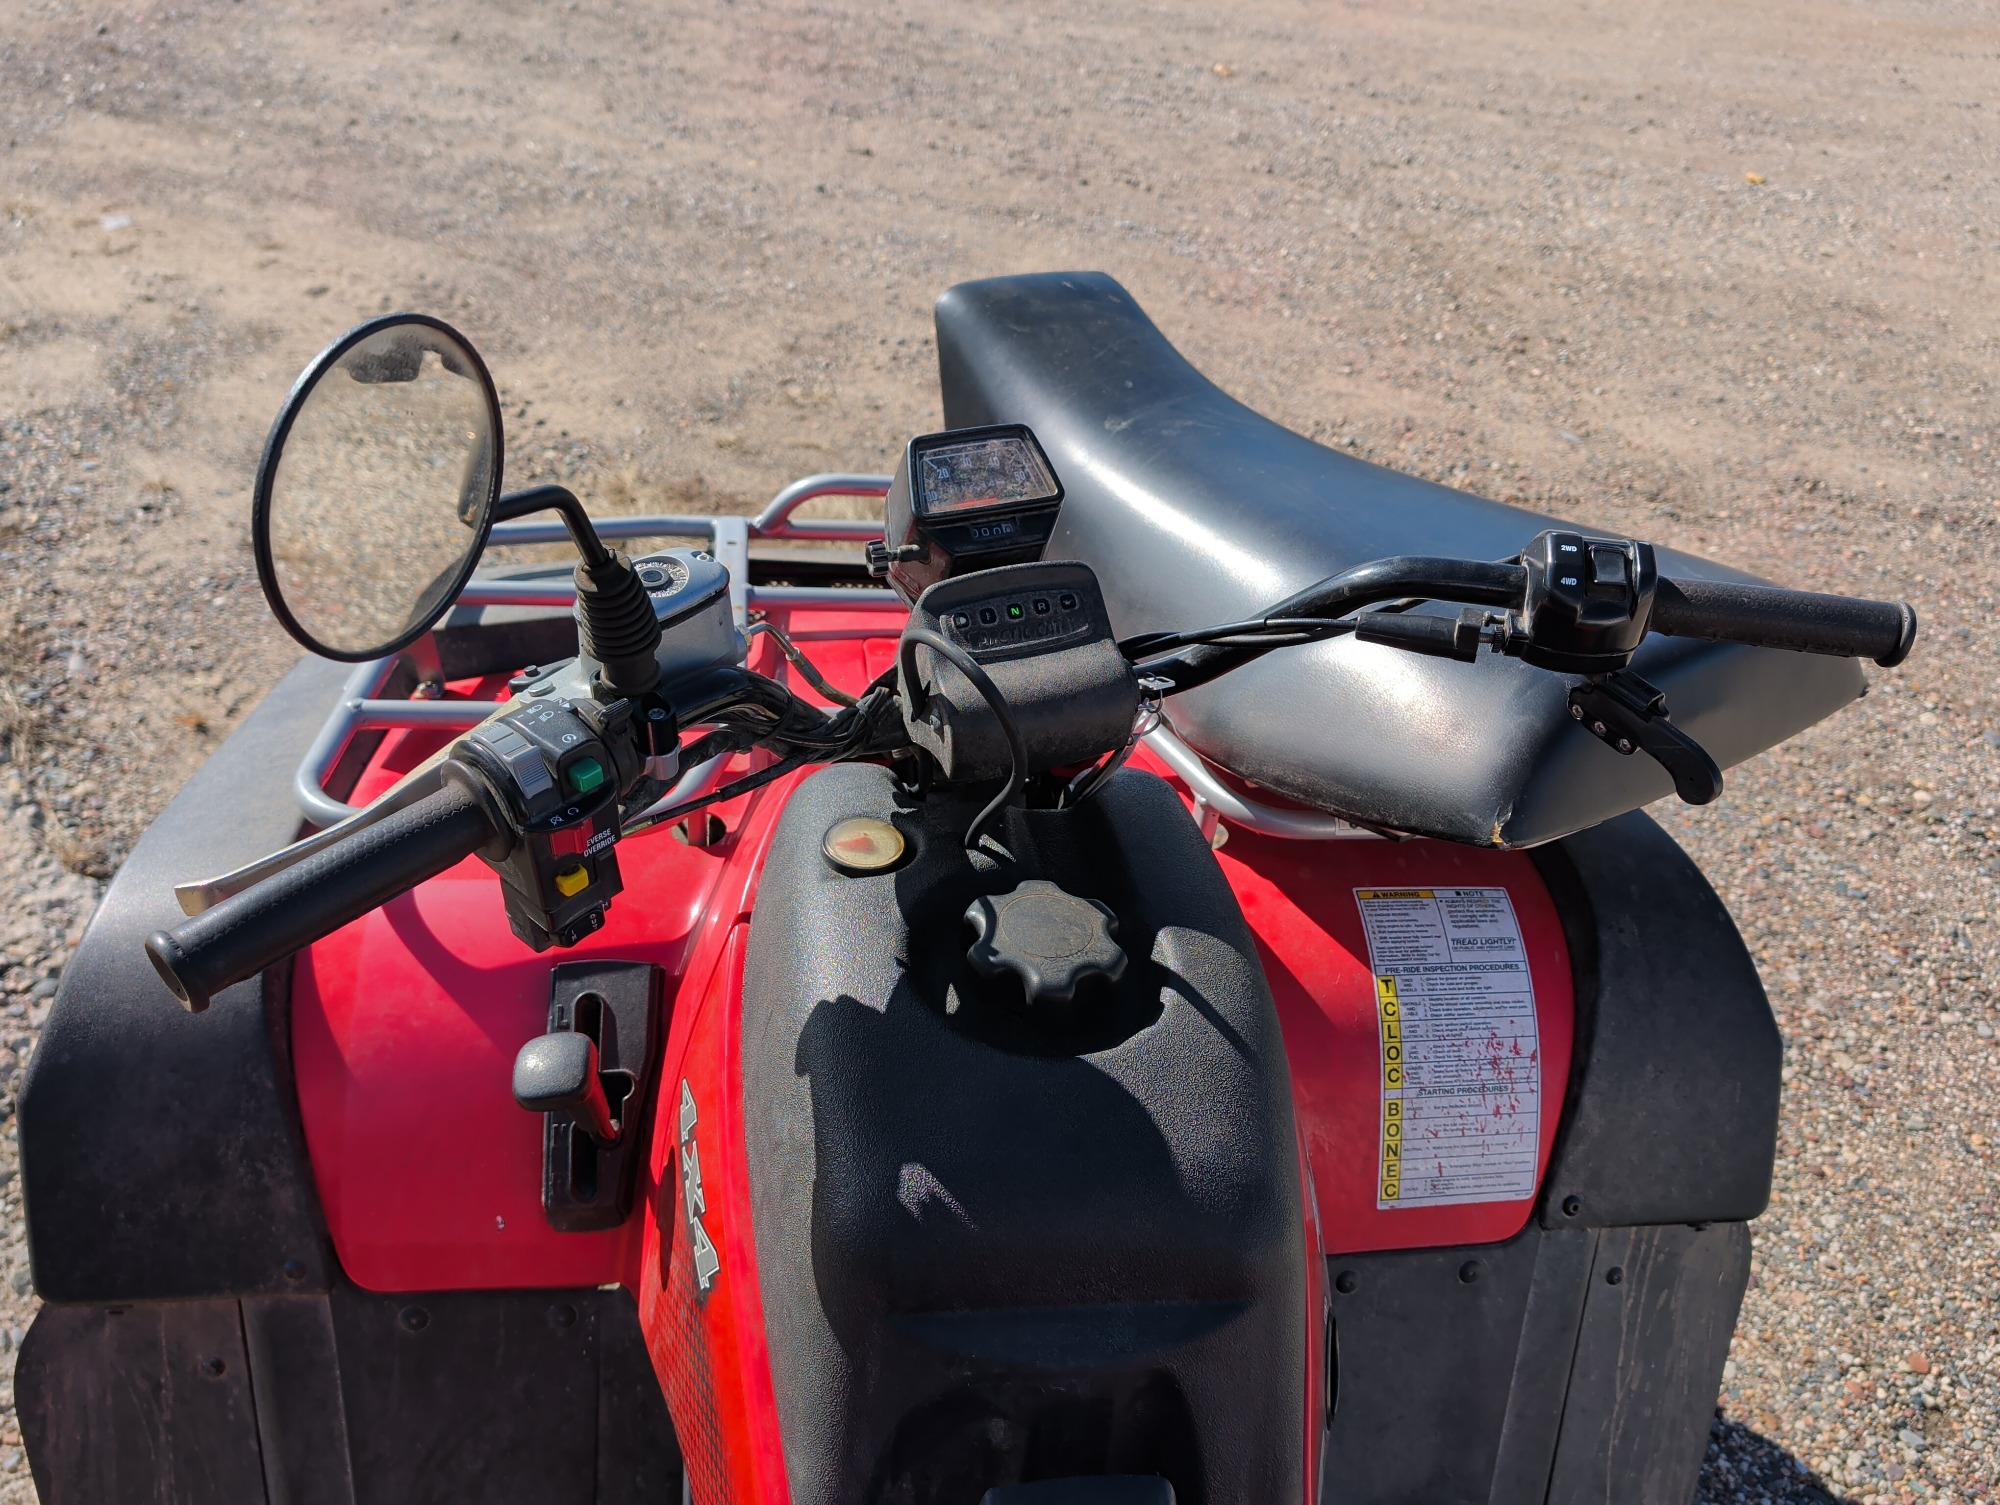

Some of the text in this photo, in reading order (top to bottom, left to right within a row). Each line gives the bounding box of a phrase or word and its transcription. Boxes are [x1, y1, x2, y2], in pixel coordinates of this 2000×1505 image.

[937, 468, 949, 479] 20
[1014, 471, 1026, 482] 50
[1561, 544, 1578, 552] 2WD
[1560, 578, 1578, 586] 4WD
[1010, 607, 1020, 616] N
[1037, 602, 1046, 611] R
[586, 828, 612, 848] EVERSE
[583, 834, 617, 858] OVERRIDE
[1451, 938, 1479, 946] TREAD
[1385, 963, 1520, 974] PRE-RIDE INSPECTION PROCEDURES
[1381, 979, 1392, 994] T
[1383, 1002, 1396, 1017] C
[1387, 1025, 1397, 1039] L
[1387, 1046, 1400, 1061] O
[1387, 1068, 1400, 1083] C
[1418, 1085, 1509, 1096] STARTING PROCEDURES
[1388, 1102, 1400, 1117] B
[1386, 1123, 1400, 1138] O
[1386, 1143, 1399, 1158] N
[1386, 1164, 1397, 1178] E
[1384, 1183, 1397, 1198] C
